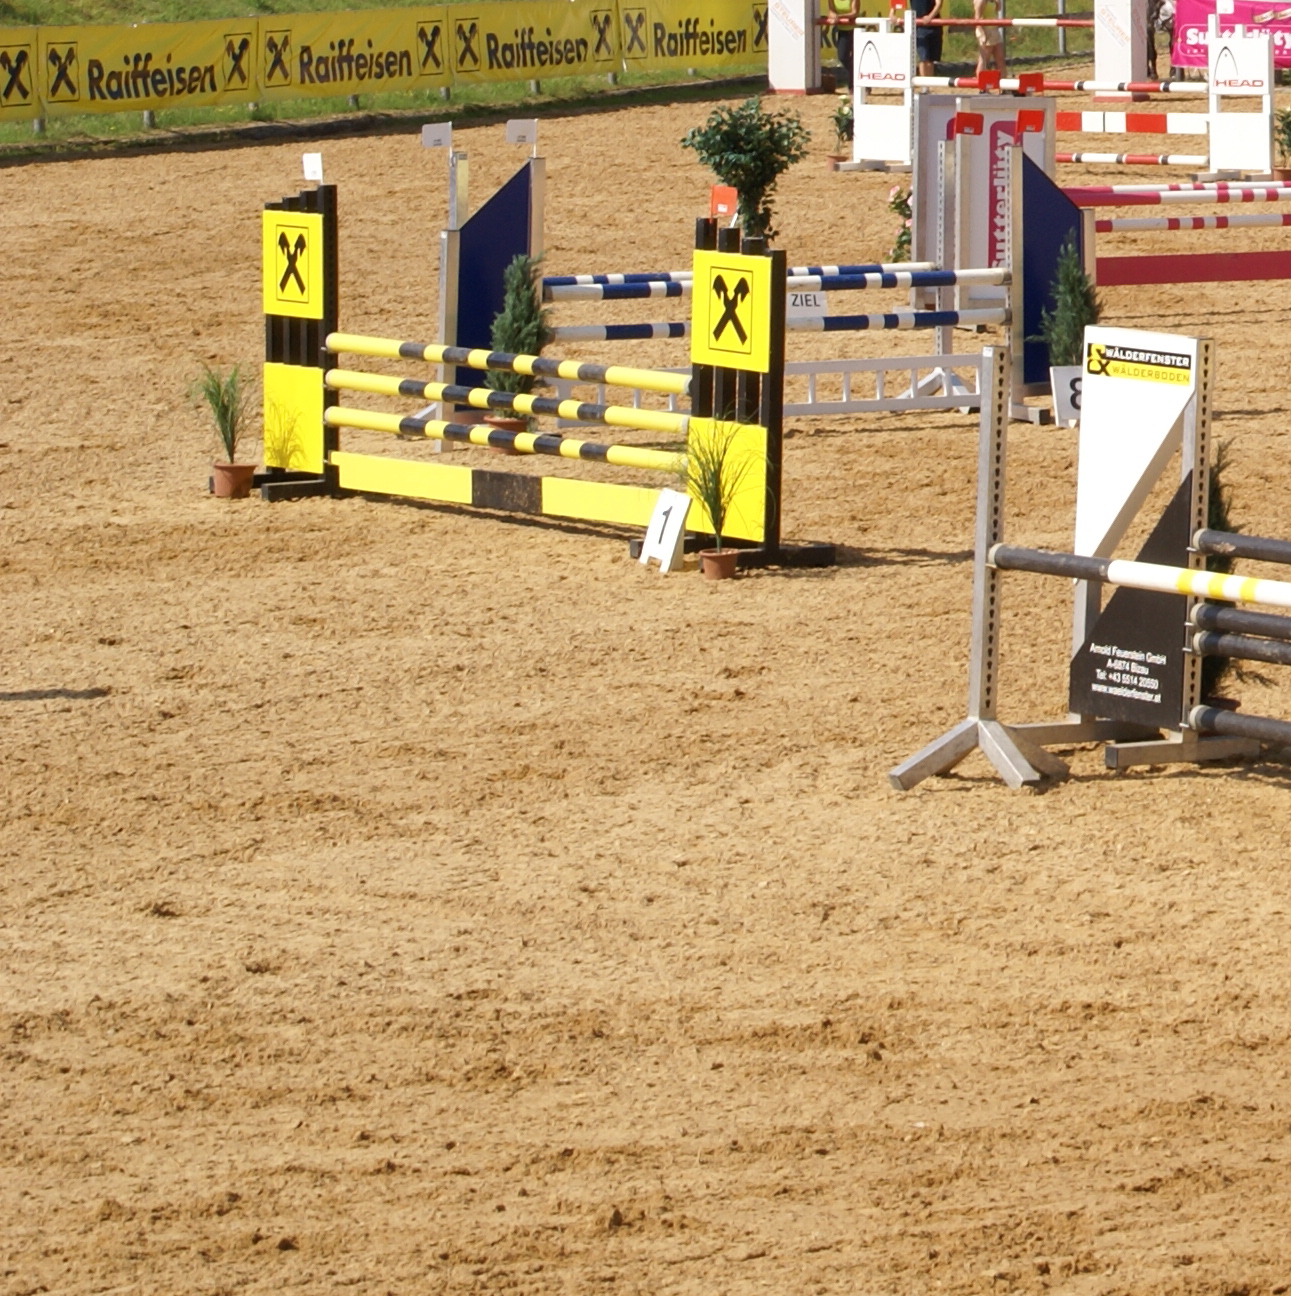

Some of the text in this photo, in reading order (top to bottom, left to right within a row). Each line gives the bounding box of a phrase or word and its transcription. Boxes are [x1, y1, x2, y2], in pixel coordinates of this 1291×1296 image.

[486, 25, 588, 71] Raiffeisen
[654, 17, 747, 57] Raiffeisen
[87, 51, 217, 101] Raiffeisen
[300, 38, 412, 86] Raiffeisen
[860, 72, 906, 81] HEAD
[1214, 79, 1264, 88] HEAD
[791, 293, 820, 308] ZIEL
[658, 505, 673, 545] 1
